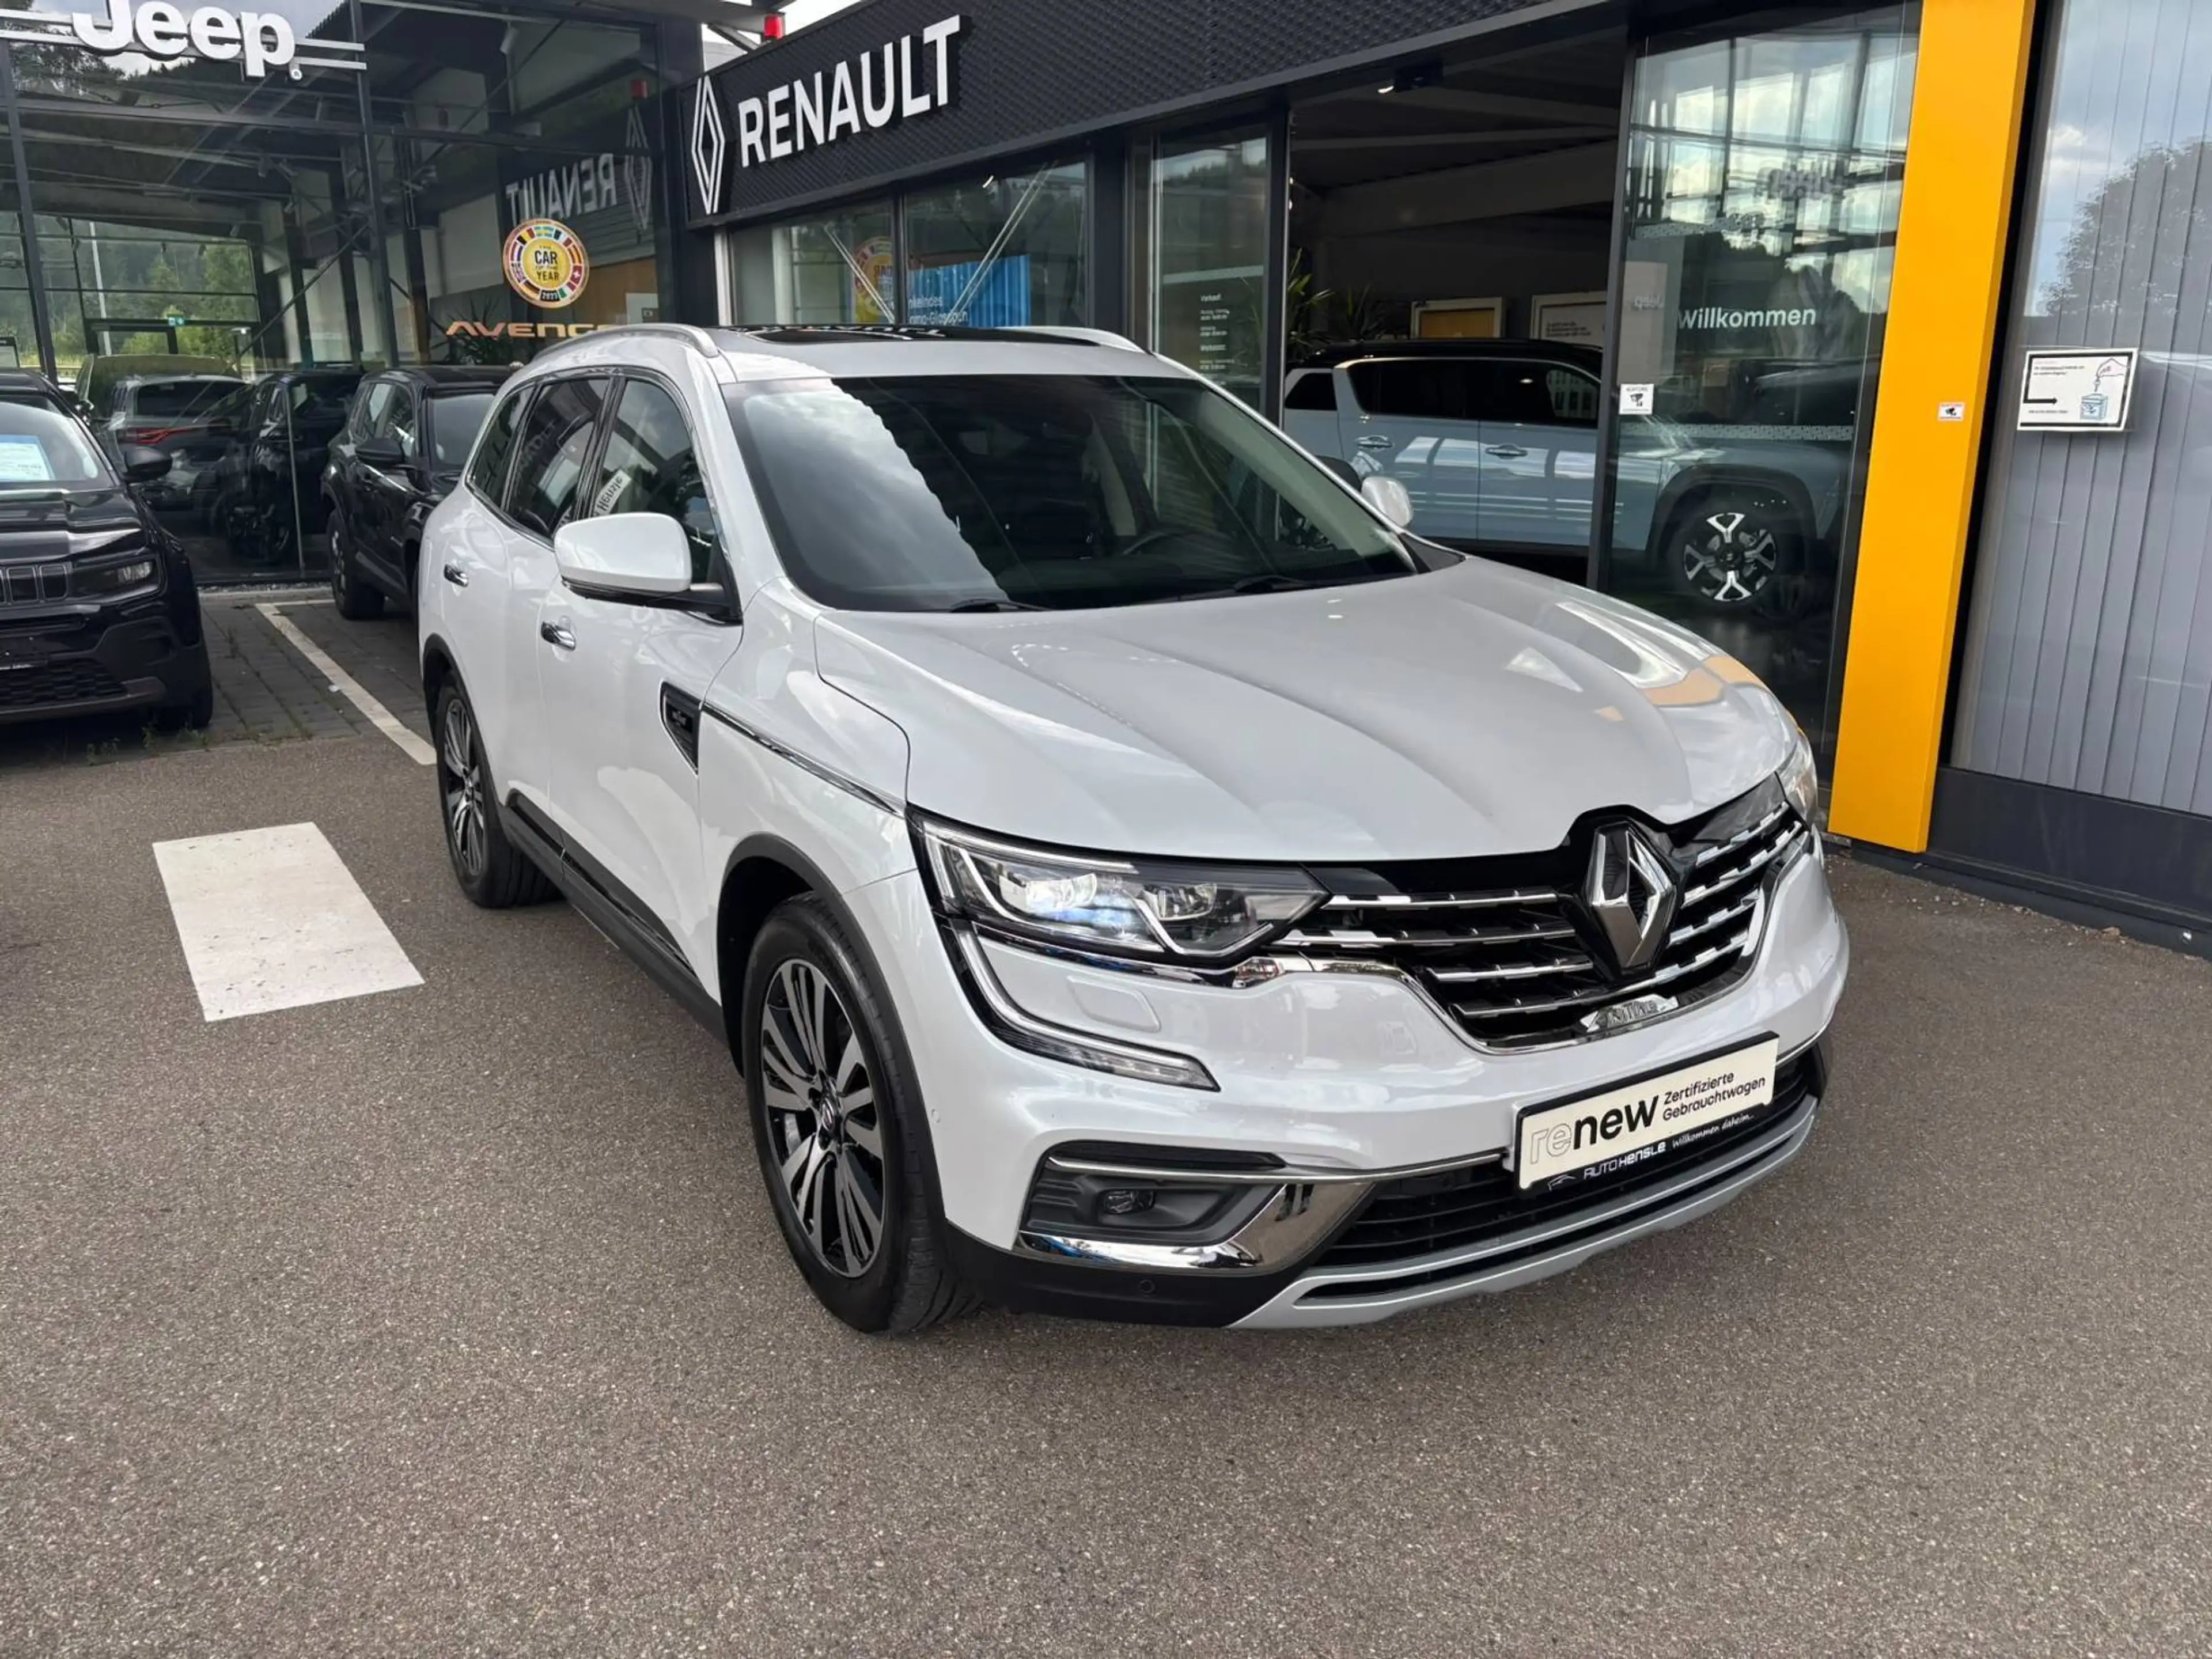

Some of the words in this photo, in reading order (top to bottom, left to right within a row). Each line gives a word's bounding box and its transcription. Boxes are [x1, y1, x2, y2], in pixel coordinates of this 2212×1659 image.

[72, 0, 296, 78] Jeep
[738, 14, 960, 168] RENAULT
[534, 250, 558, 265] CAR
[536, 271, 560, 281] YEAR
[1679, 307, 1816, 329] Willkommen
[1662, 1077, 1766, 1121] Gebrauchtwagen
[1664, 1072, 1734, 1105] Zertifizierte
[1530, 1095, 1659, 1165] renew
